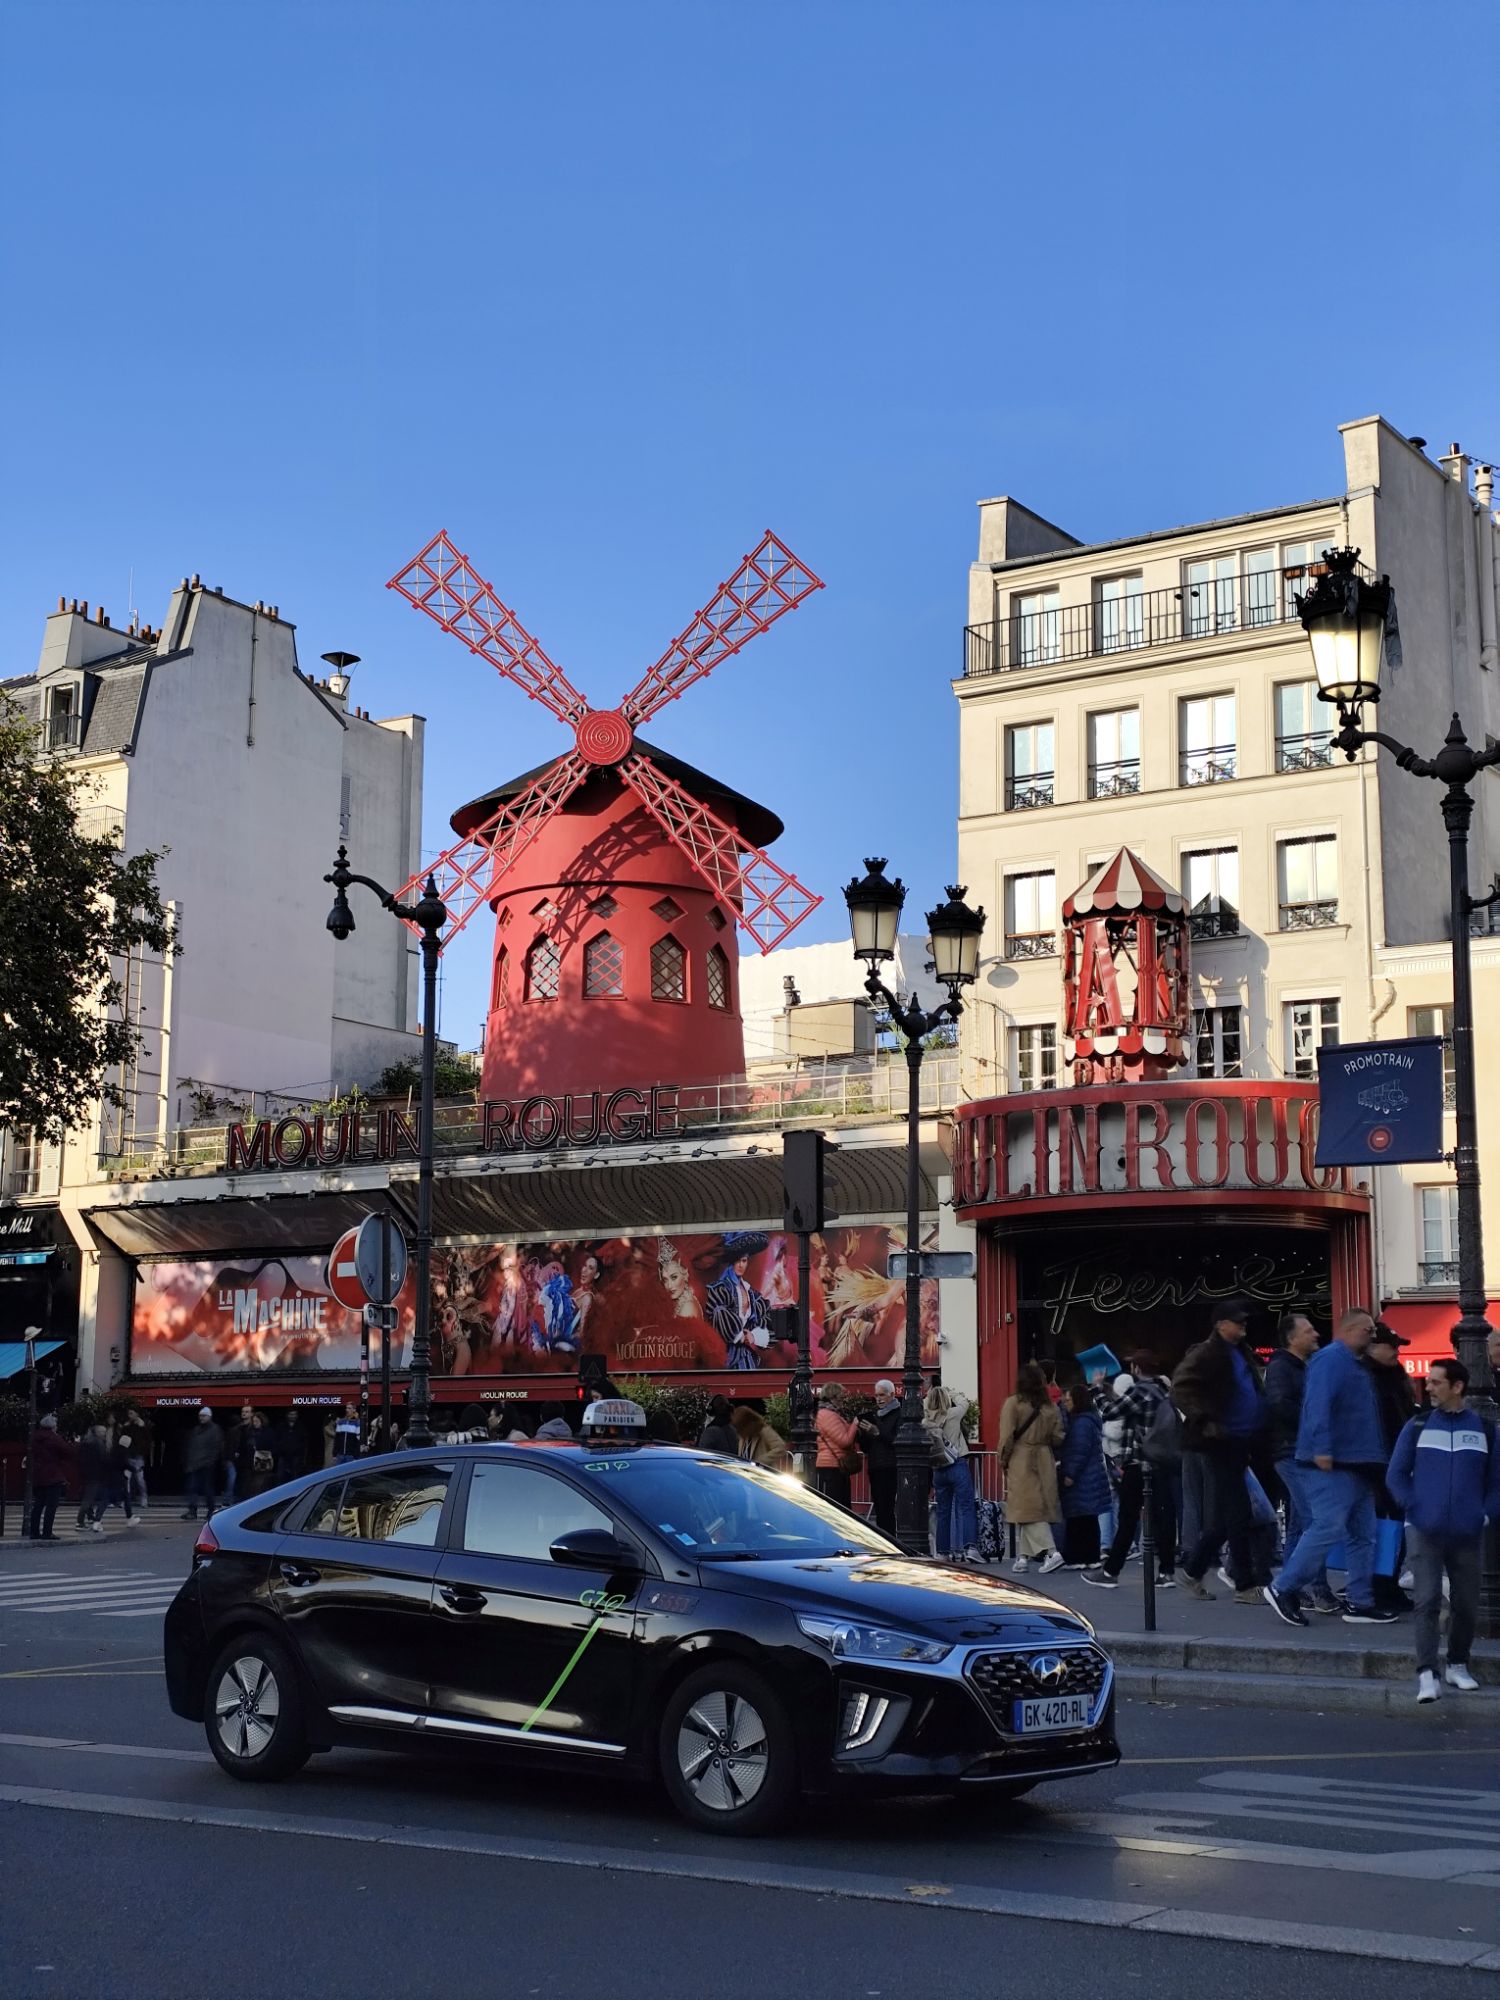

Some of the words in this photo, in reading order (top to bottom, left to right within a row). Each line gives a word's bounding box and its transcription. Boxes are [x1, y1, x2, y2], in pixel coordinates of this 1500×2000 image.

[1073, 1056, 1125, 1088] DU
[1343, 1053, 1415, 1075] PROMOTRAIN
[227, 1106, 422, 1170] MOULIN
[484, 1083, 686, 1151] ROUGE
[8, 1216, 34, 1235] Mill
[219, 1289, 233, 1306] LA
[628, 1324, 681, 1345] Forever
[616, 1342, 656, 1361] MOULIN
[658, 1340, 696, 1359] ROUGE
[156, 1398, 180, 1406] MOULIN
[292, 1397, 318, 1405] MOULIN
[480, 1391, 505, 1399] MOULIN
[505, 1391, 529, 1399] ROUGE
[606, 1401, 630, 1415] TAXI
[604, 1415, 635, 1424] PARISIEN
[584, 1461, 610, 1472] G7
[580, 1589, 608, 1608] G7
